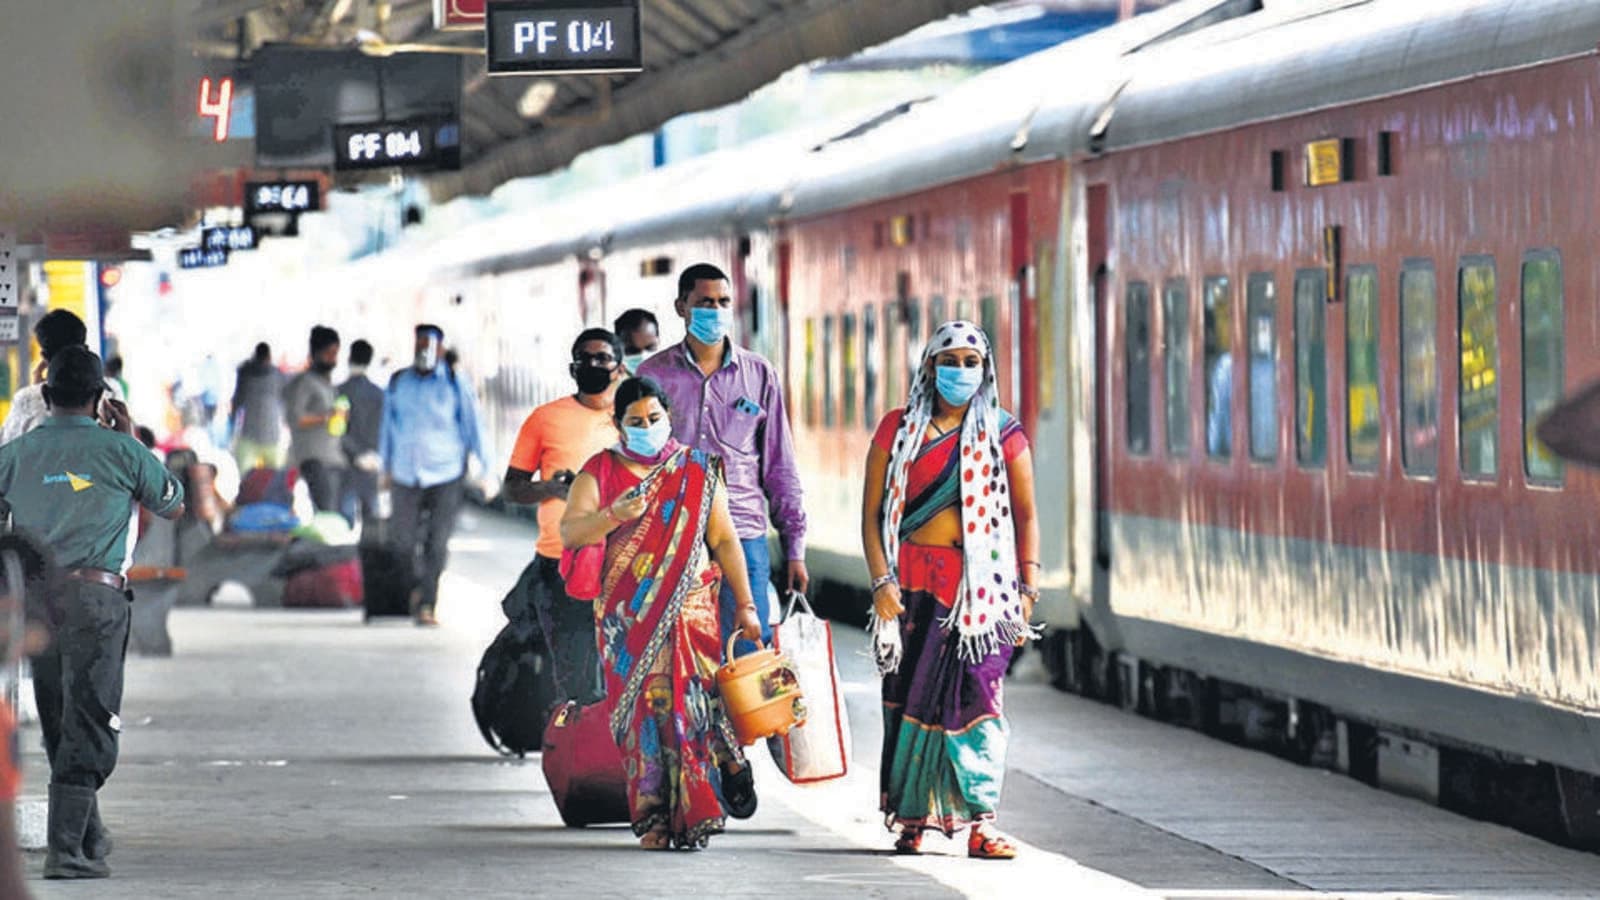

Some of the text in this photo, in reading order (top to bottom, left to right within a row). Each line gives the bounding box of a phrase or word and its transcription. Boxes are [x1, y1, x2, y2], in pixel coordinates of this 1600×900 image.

[514, 19, 614, 54] PF 04
[198, 76, 235, 142] 4
